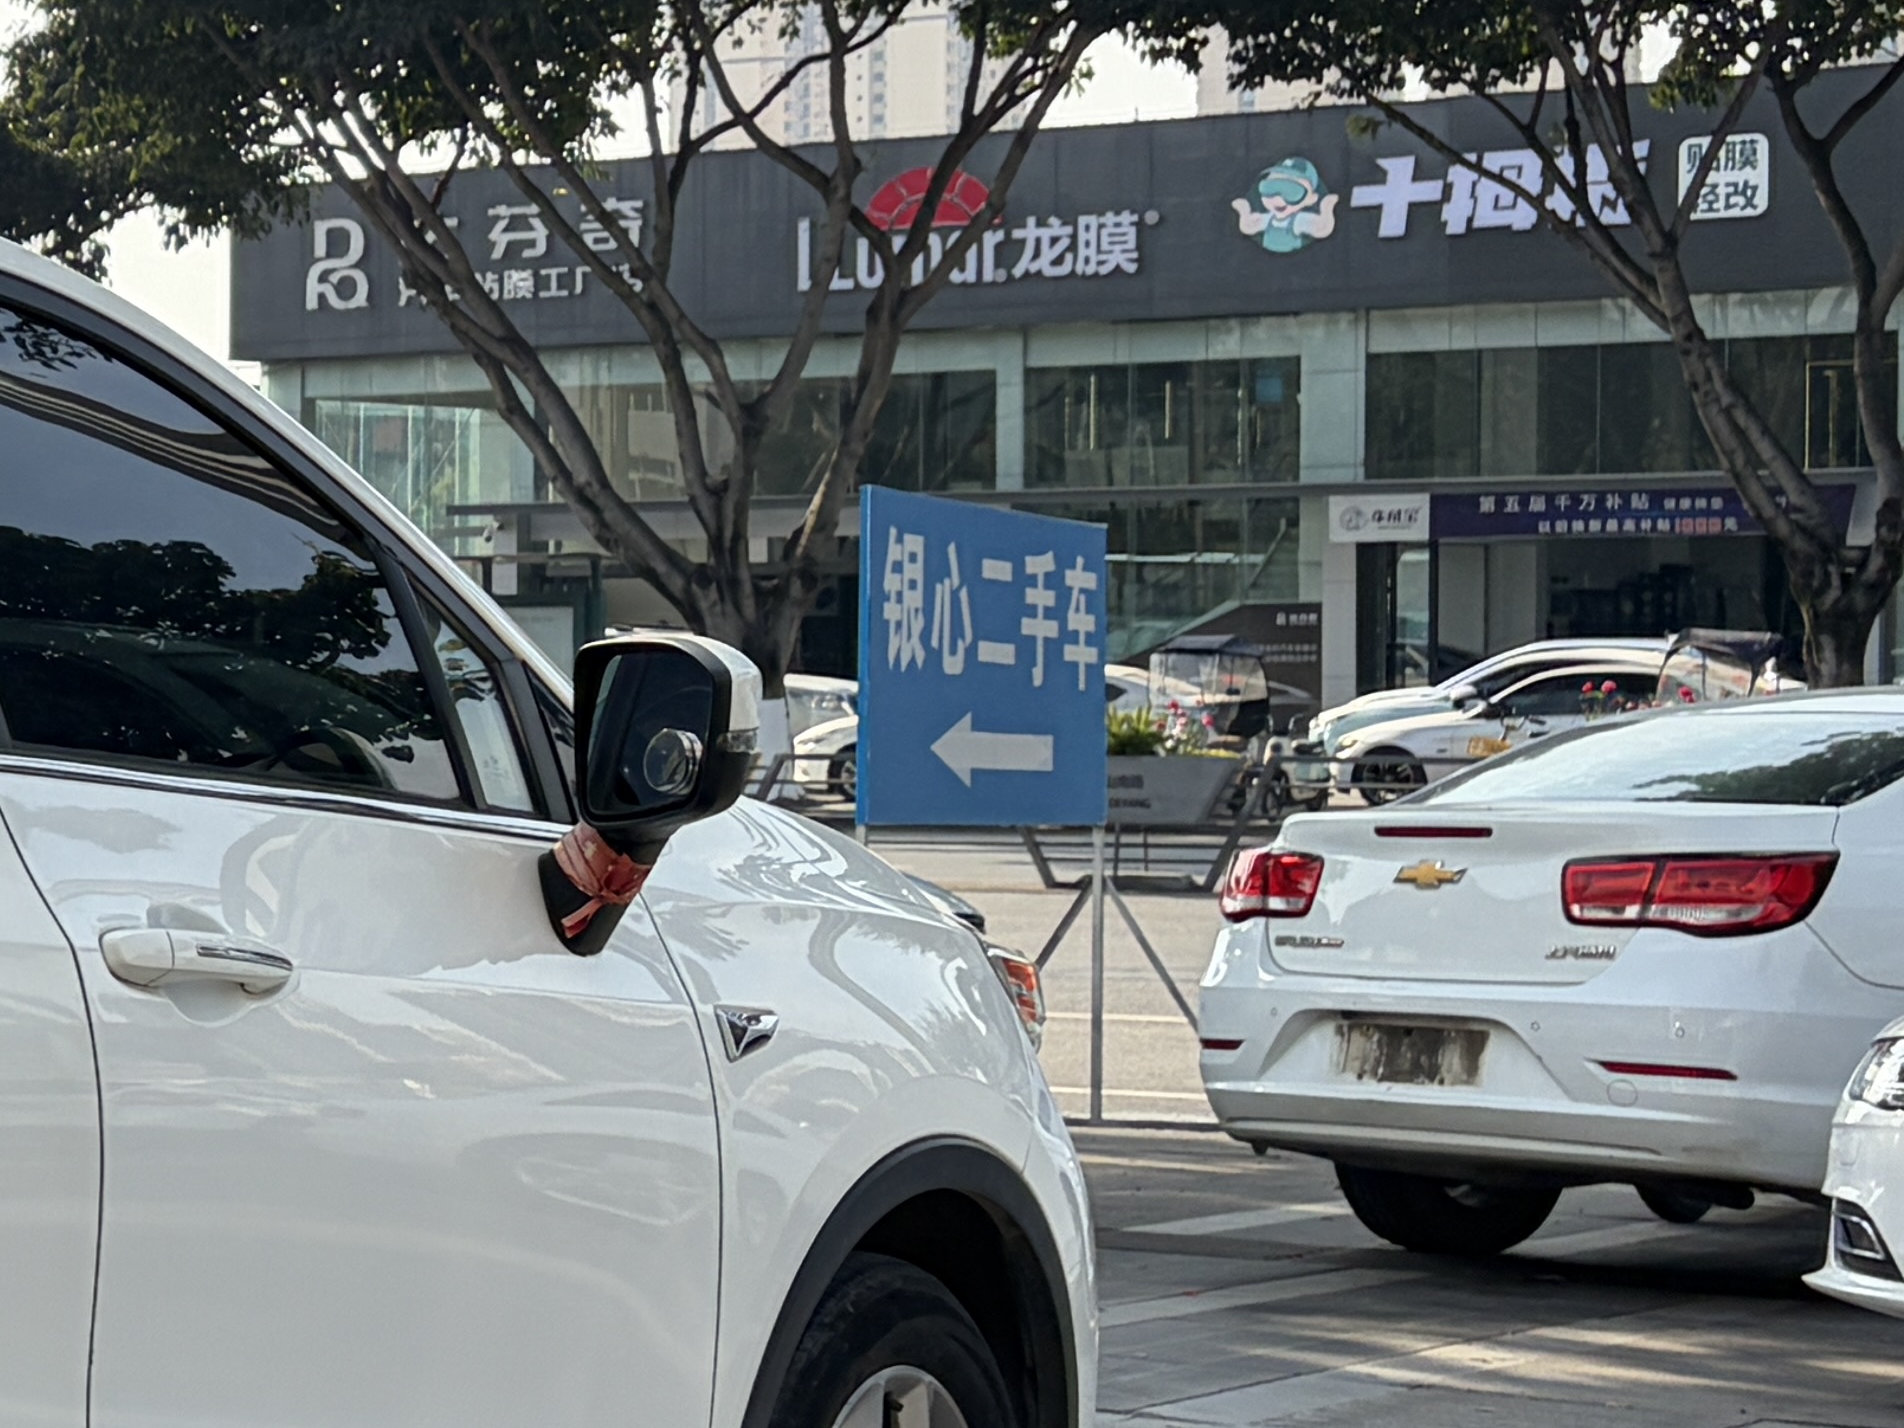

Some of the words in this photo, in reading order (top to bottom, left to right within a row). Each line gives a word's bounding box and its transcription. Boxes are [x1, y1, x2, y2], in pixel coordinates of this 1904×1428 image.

[400, 196, 644, 264] 芬奇
[1011, 209, 1140, 280] 龙膜
[883, 526, 1098, 691] 银心二手车
